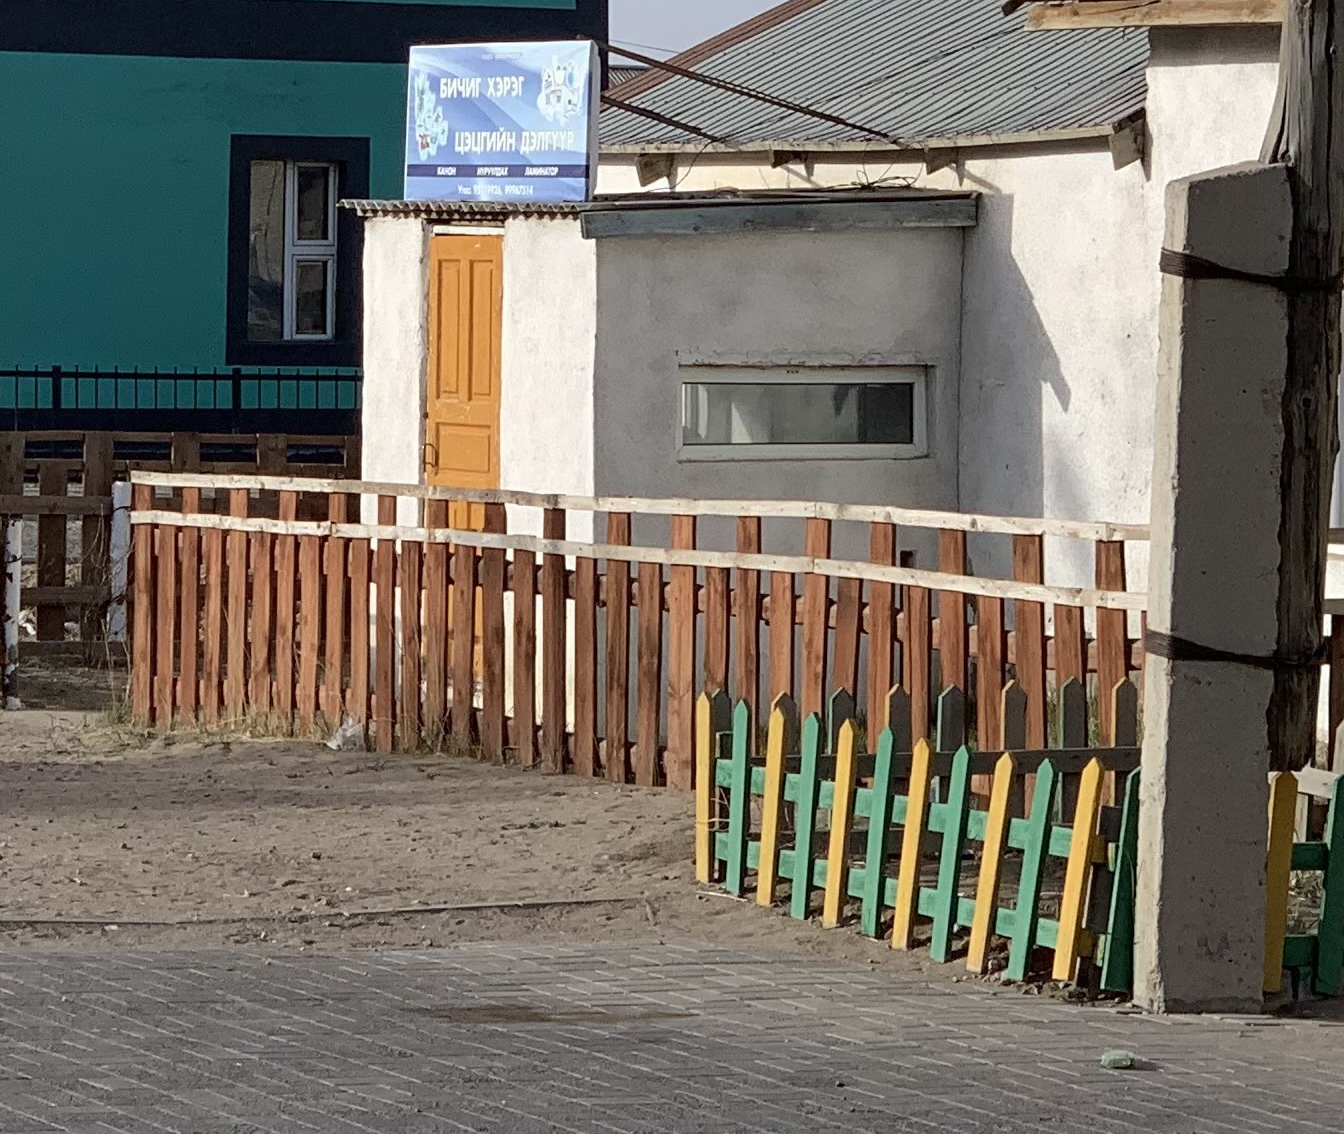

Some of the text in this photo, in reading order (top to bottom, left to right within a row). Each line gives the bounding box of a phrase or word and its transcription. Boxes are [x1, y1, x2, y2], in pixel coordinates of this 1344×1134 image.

[440, 76, 525, 99] БИЧИГ ХЭРЭГ
[455, 127, 575, 155] ЦЭЦГИЙН ДЭЛГҮҮР
